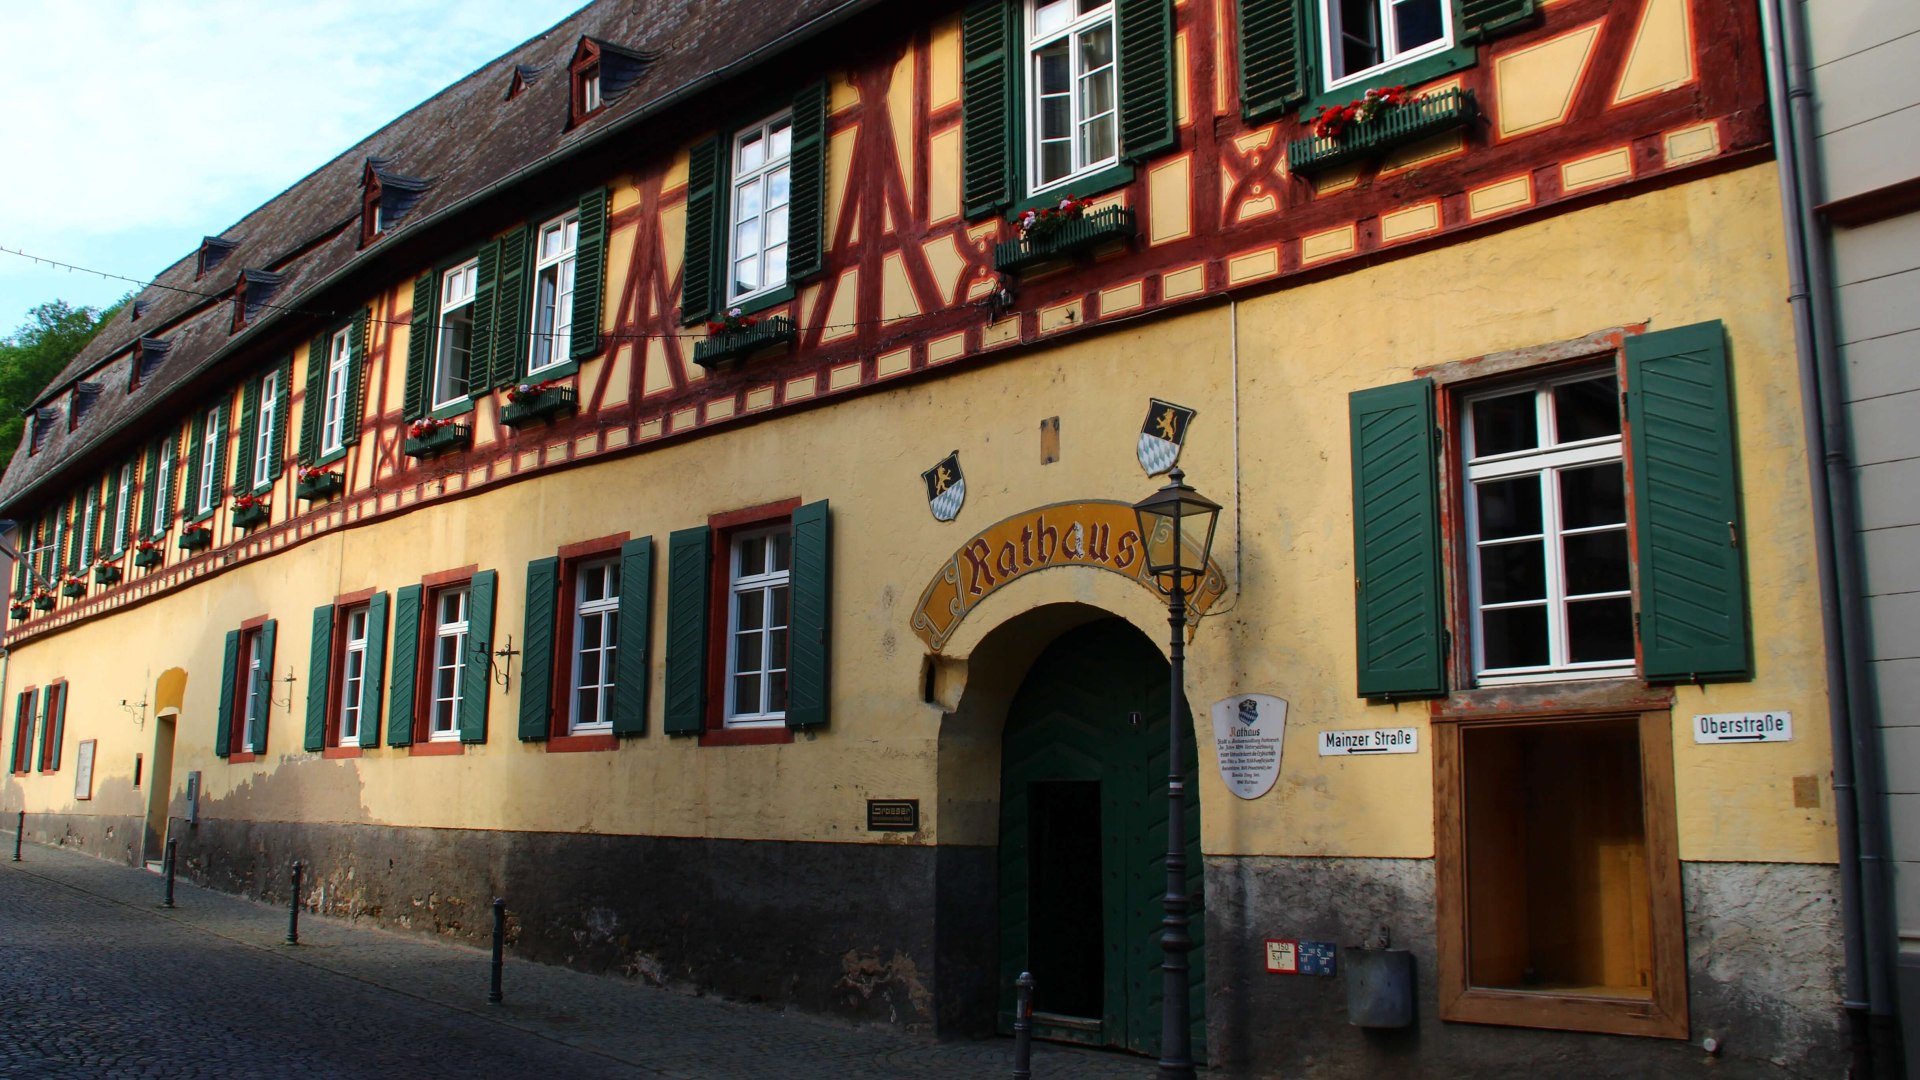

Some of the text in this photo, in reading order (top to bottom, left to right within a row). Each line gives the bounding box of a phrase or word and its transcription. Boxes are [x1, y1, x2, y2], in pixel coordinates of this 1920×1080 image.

[963, 514, 1140, 596] Rathaus
[1700, 714, 1784, 734] Oberstraße
[1229, 726, 1260, 737] Rathaus
[1326, 730, 1411, 747] Mainzer Straße
[1277, 942, 1289, 951] 150
[1298, 944, 1304, 953] S
[1316, 948, 1322, 957] S
